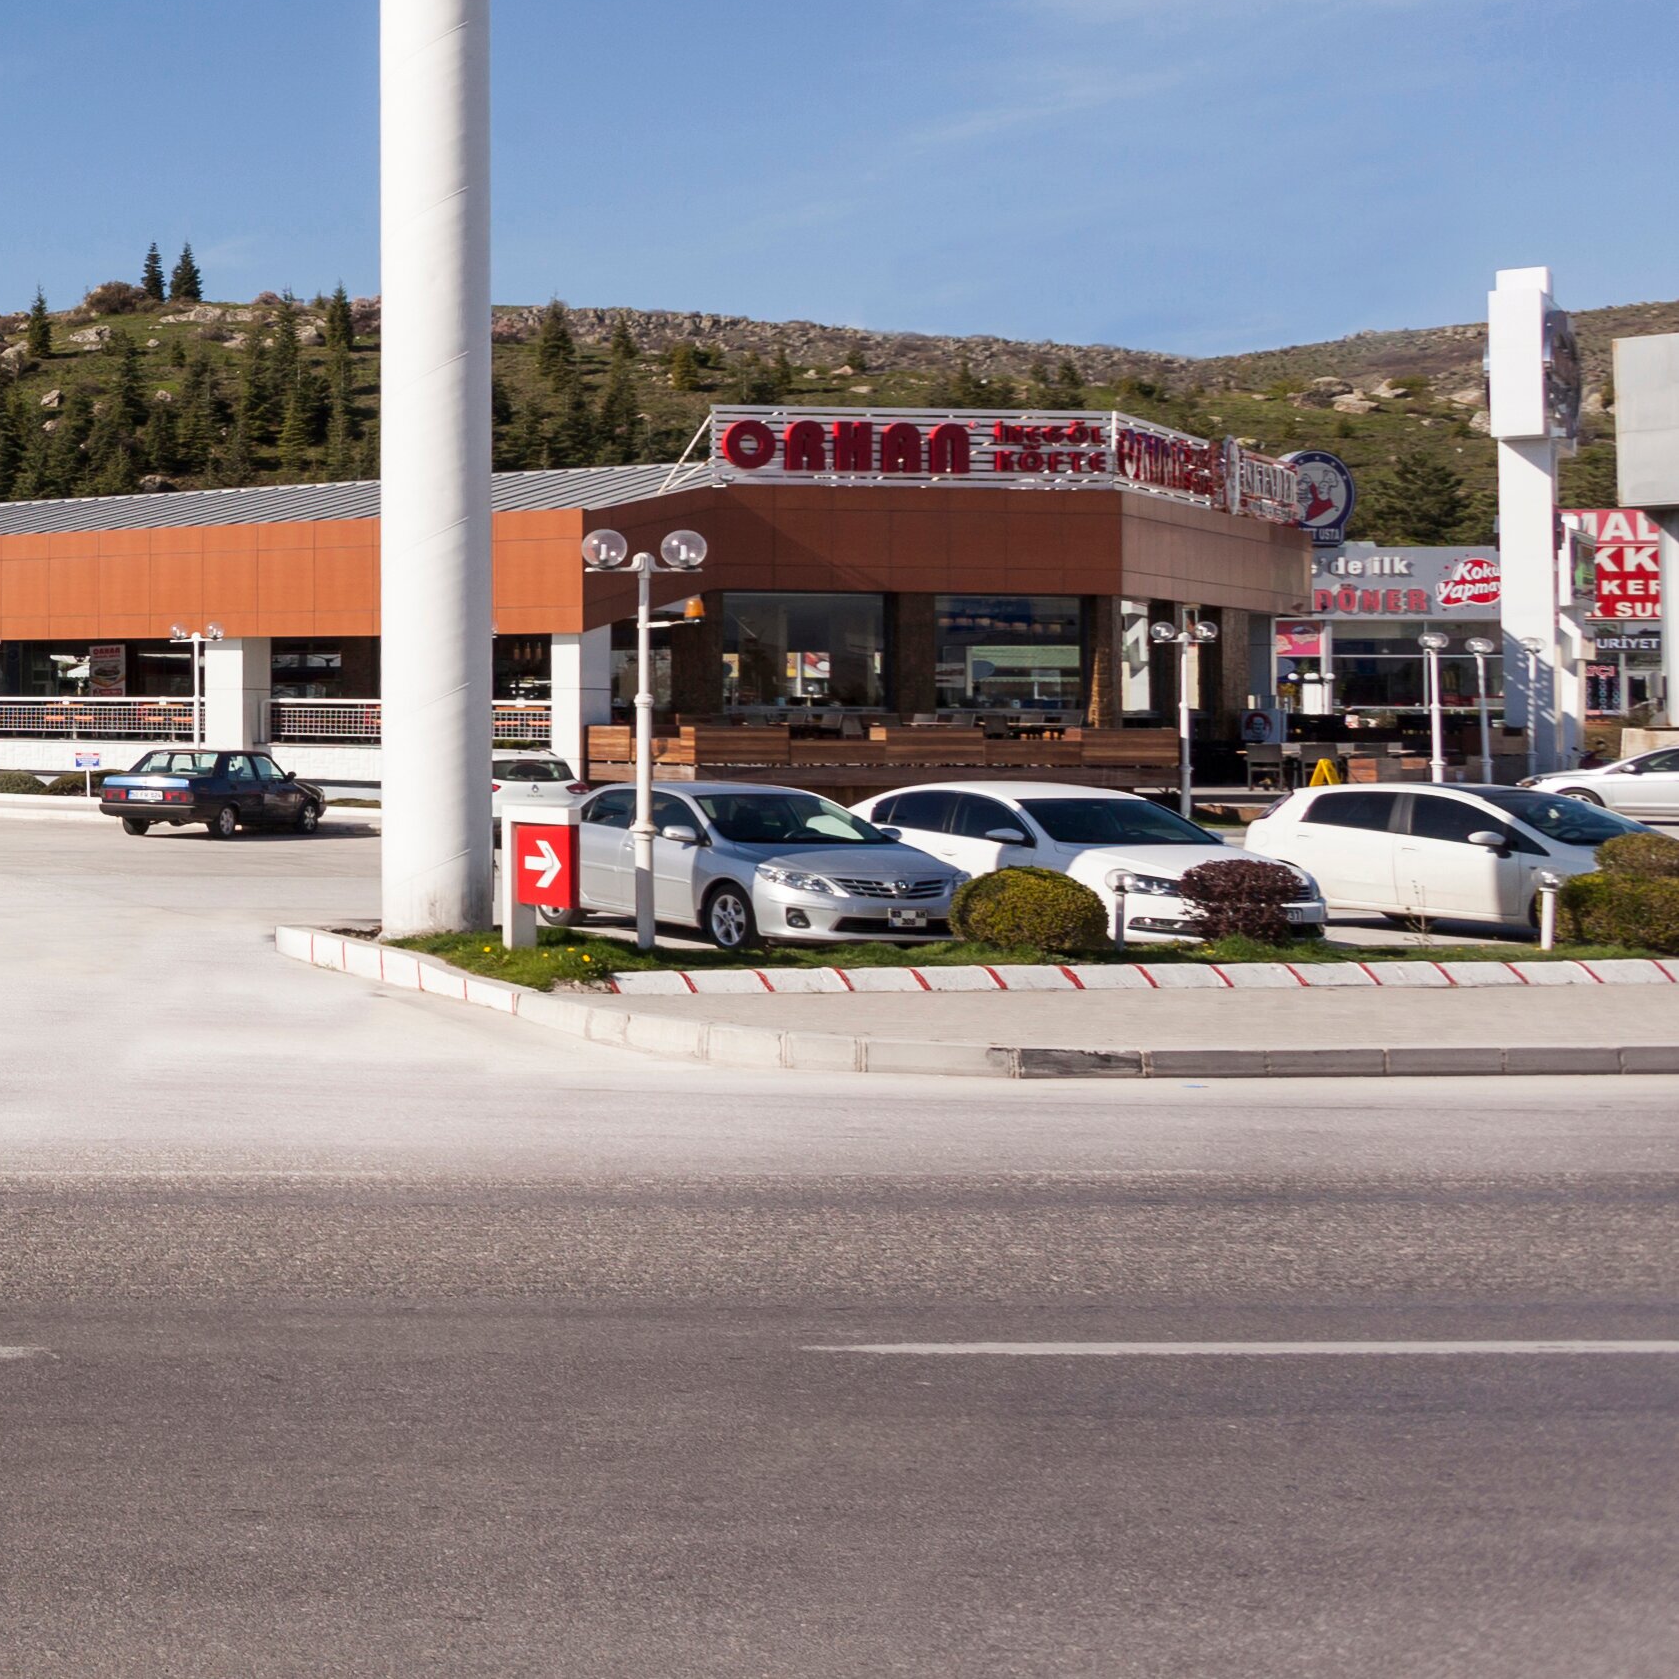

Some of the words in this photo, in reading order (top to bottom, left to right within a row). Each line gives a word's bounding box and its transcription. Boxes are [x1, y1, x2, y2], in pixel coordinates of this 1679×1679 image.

[721, 420, 970, 473] ORHAN
[993, 445, 1107, 473] KÖFTE
[1371, 556, 1410, 575] ilk
[1314, 583, 1428, 611] DÖNER
